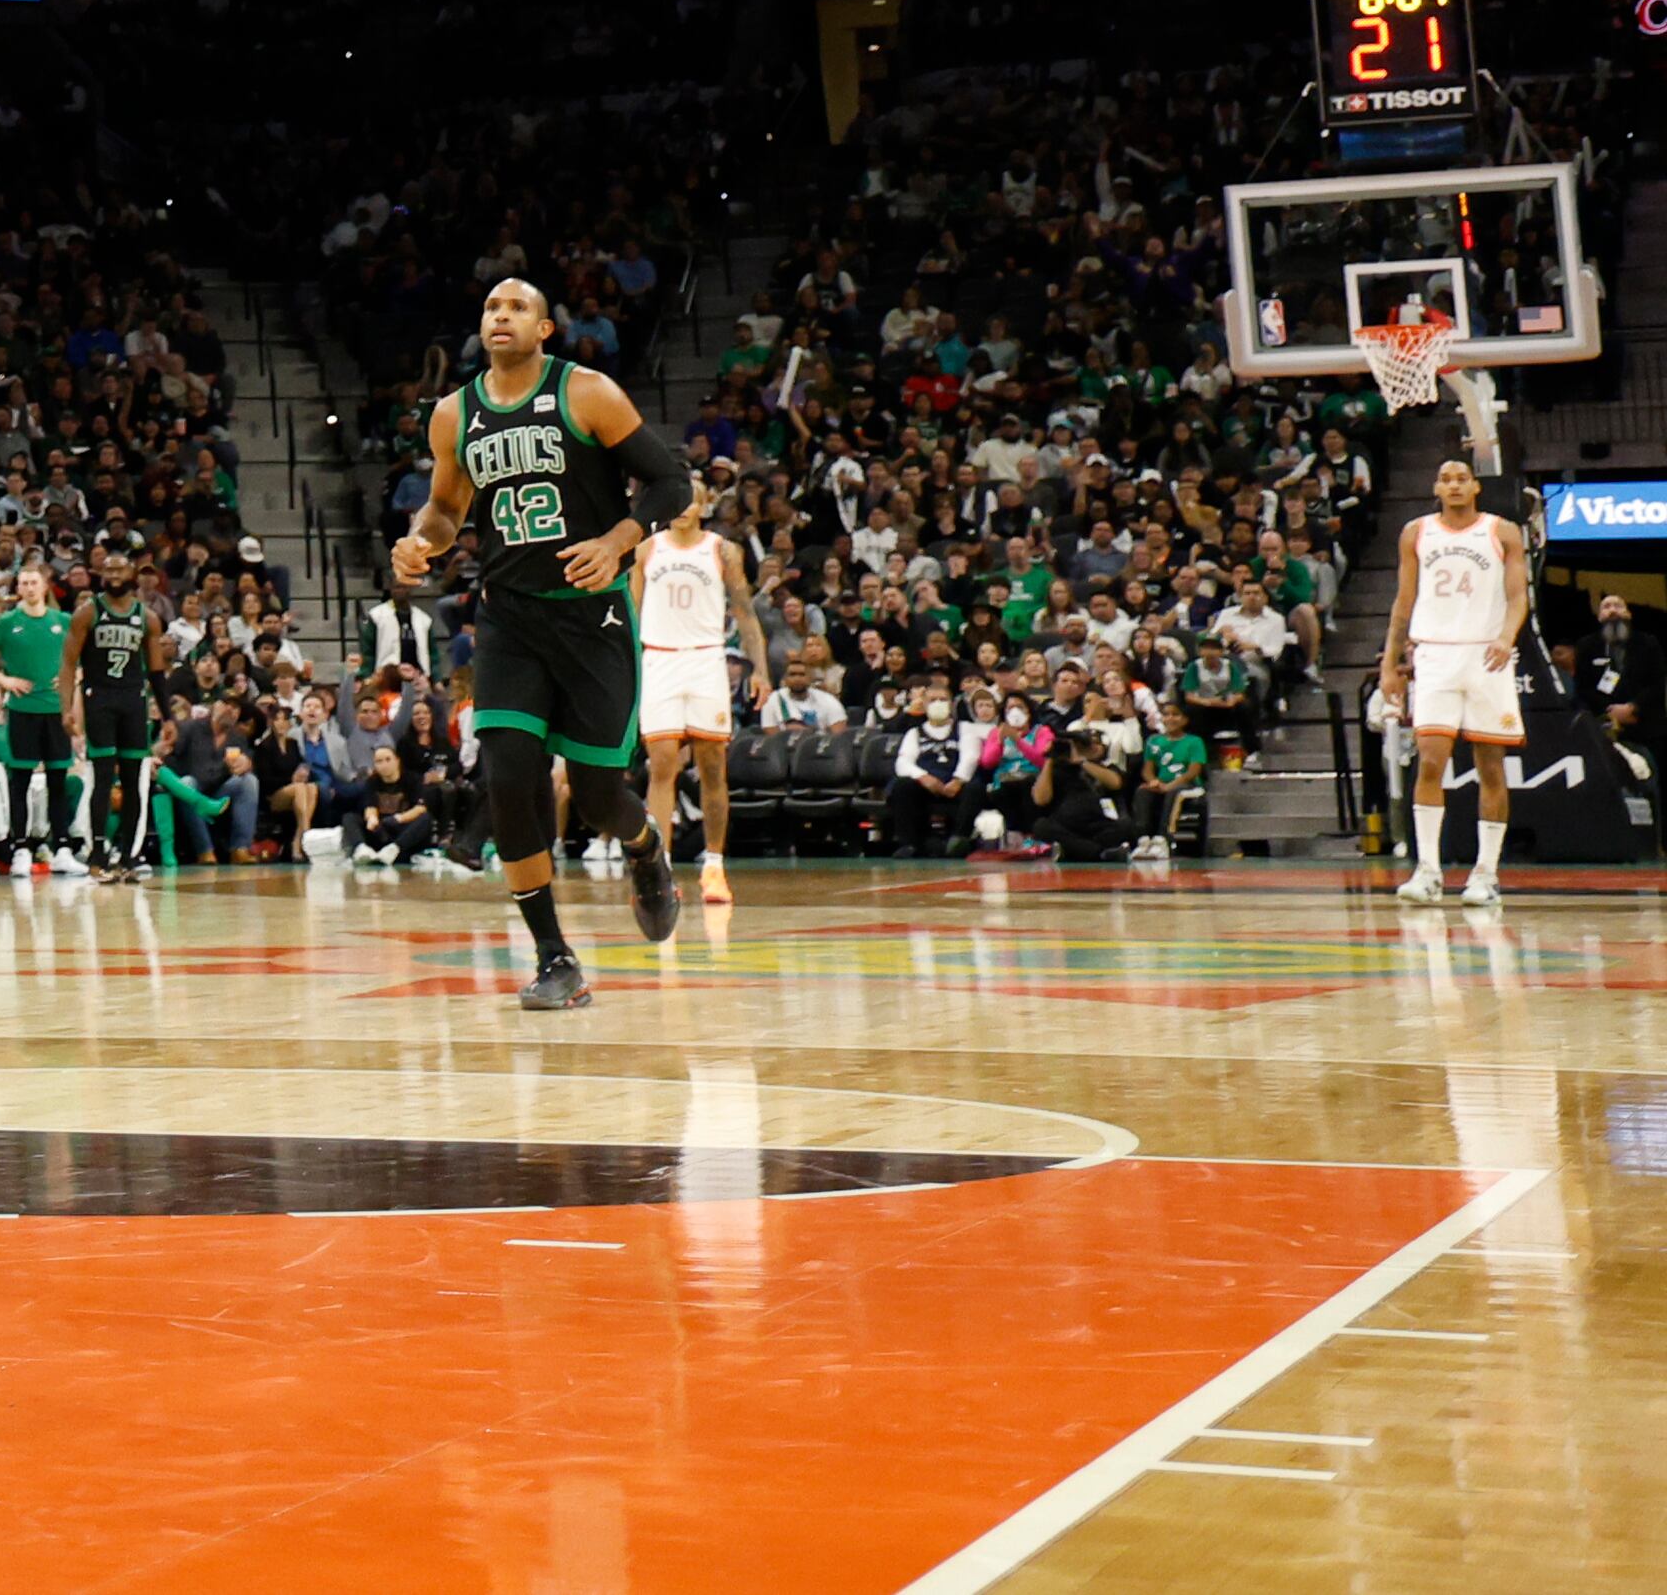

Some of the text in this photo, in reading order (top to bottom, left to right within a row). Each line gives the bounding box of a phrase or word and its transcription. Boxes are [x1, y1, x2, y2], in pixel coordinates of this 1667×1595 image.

[1351, 16, 1443, 83] 21
[466, 425, 566, 489] CELTICS
[492, 481, 567, 546] 42
[667, 582, 694, 610] 10
[1434, 569, 1474, 598] 24
[107, 649, 130, 678] 7
